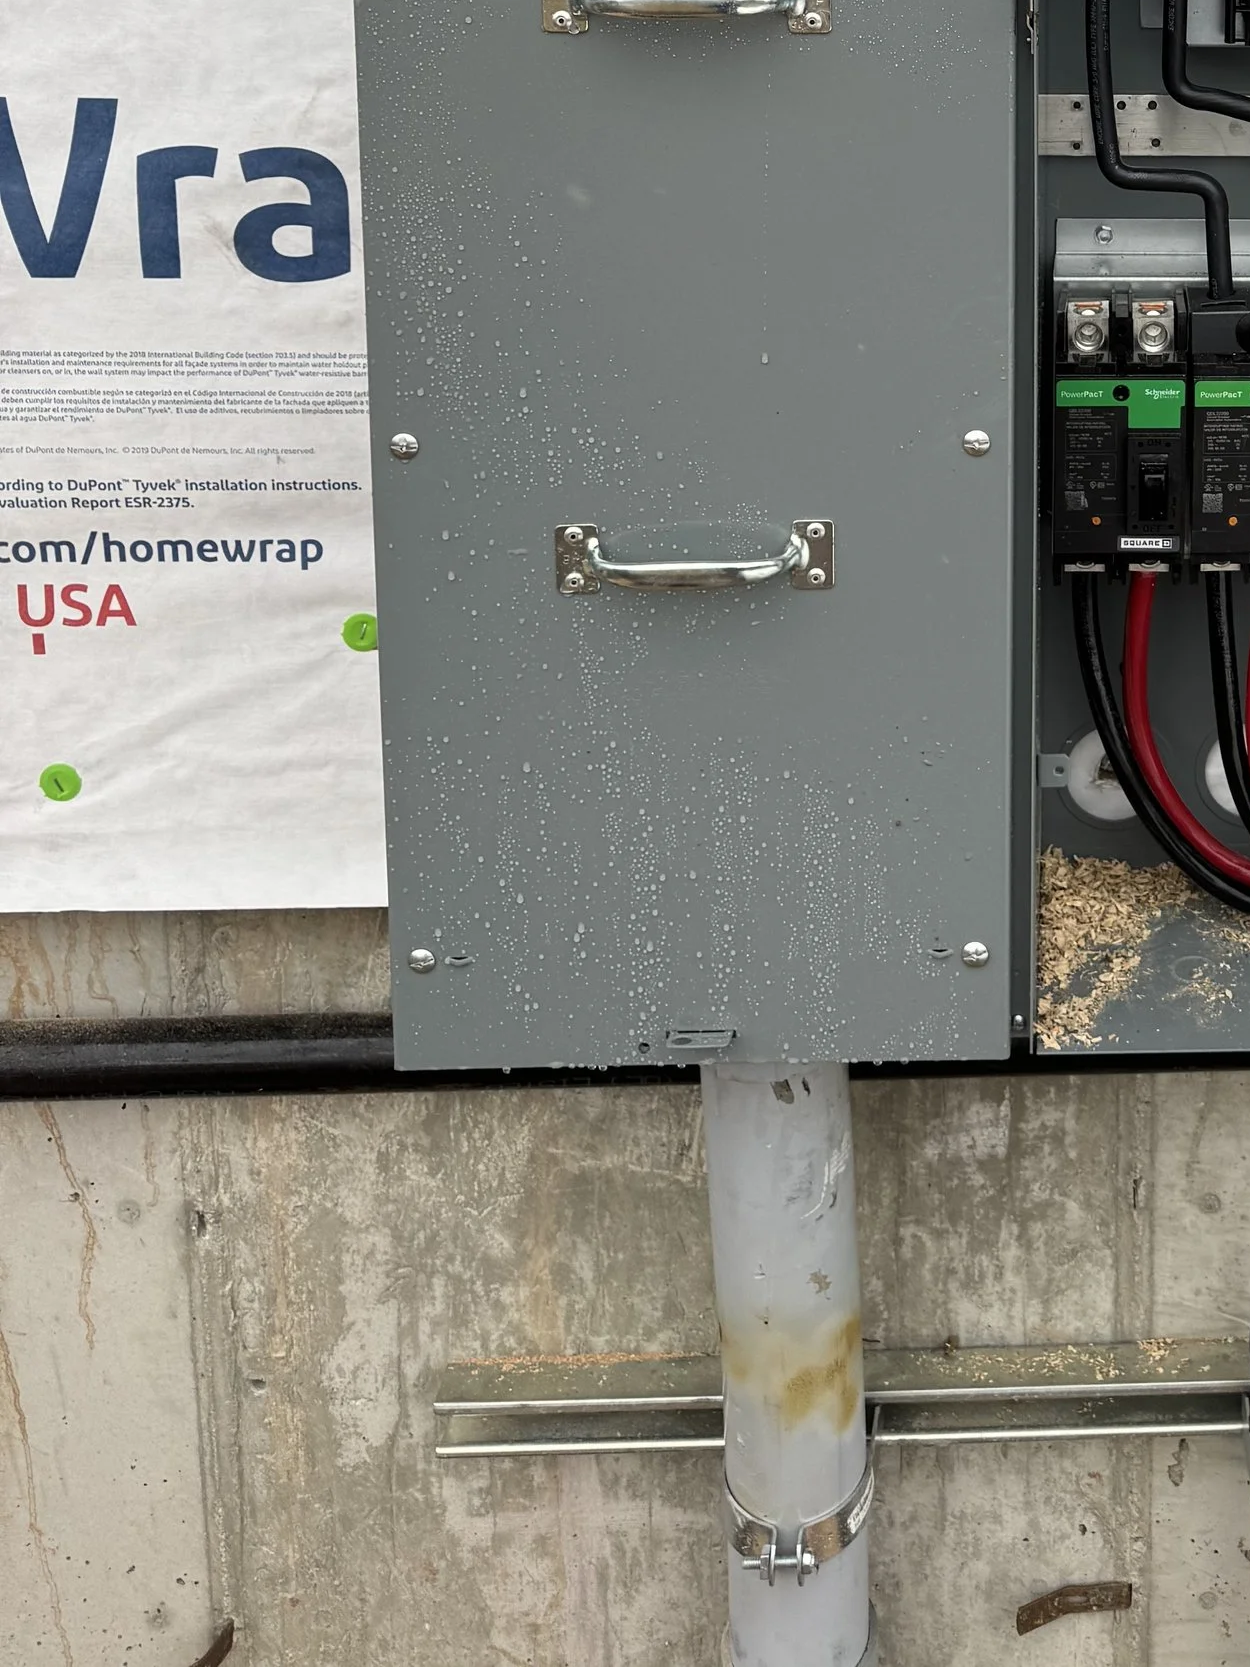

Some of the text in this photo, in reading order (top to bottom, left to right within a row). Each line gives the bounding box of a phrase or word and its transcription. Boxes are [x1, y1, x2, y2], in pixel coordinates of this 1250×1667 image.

[1061, 390, 1104, 398] PowerPacT
[1145, 388, 1181, 397] Schneider
[1200, 391, 1243, 399] PowerPacT
[49, 480, 63, 491] to
[185, 479, 267, 491] installation
[272, 479, 362, 491] instructions.
[72, 497, 121, 510] Report
[125, 497, 195, 508] ESR-2375.
[17, 583, 137, 627] USA
